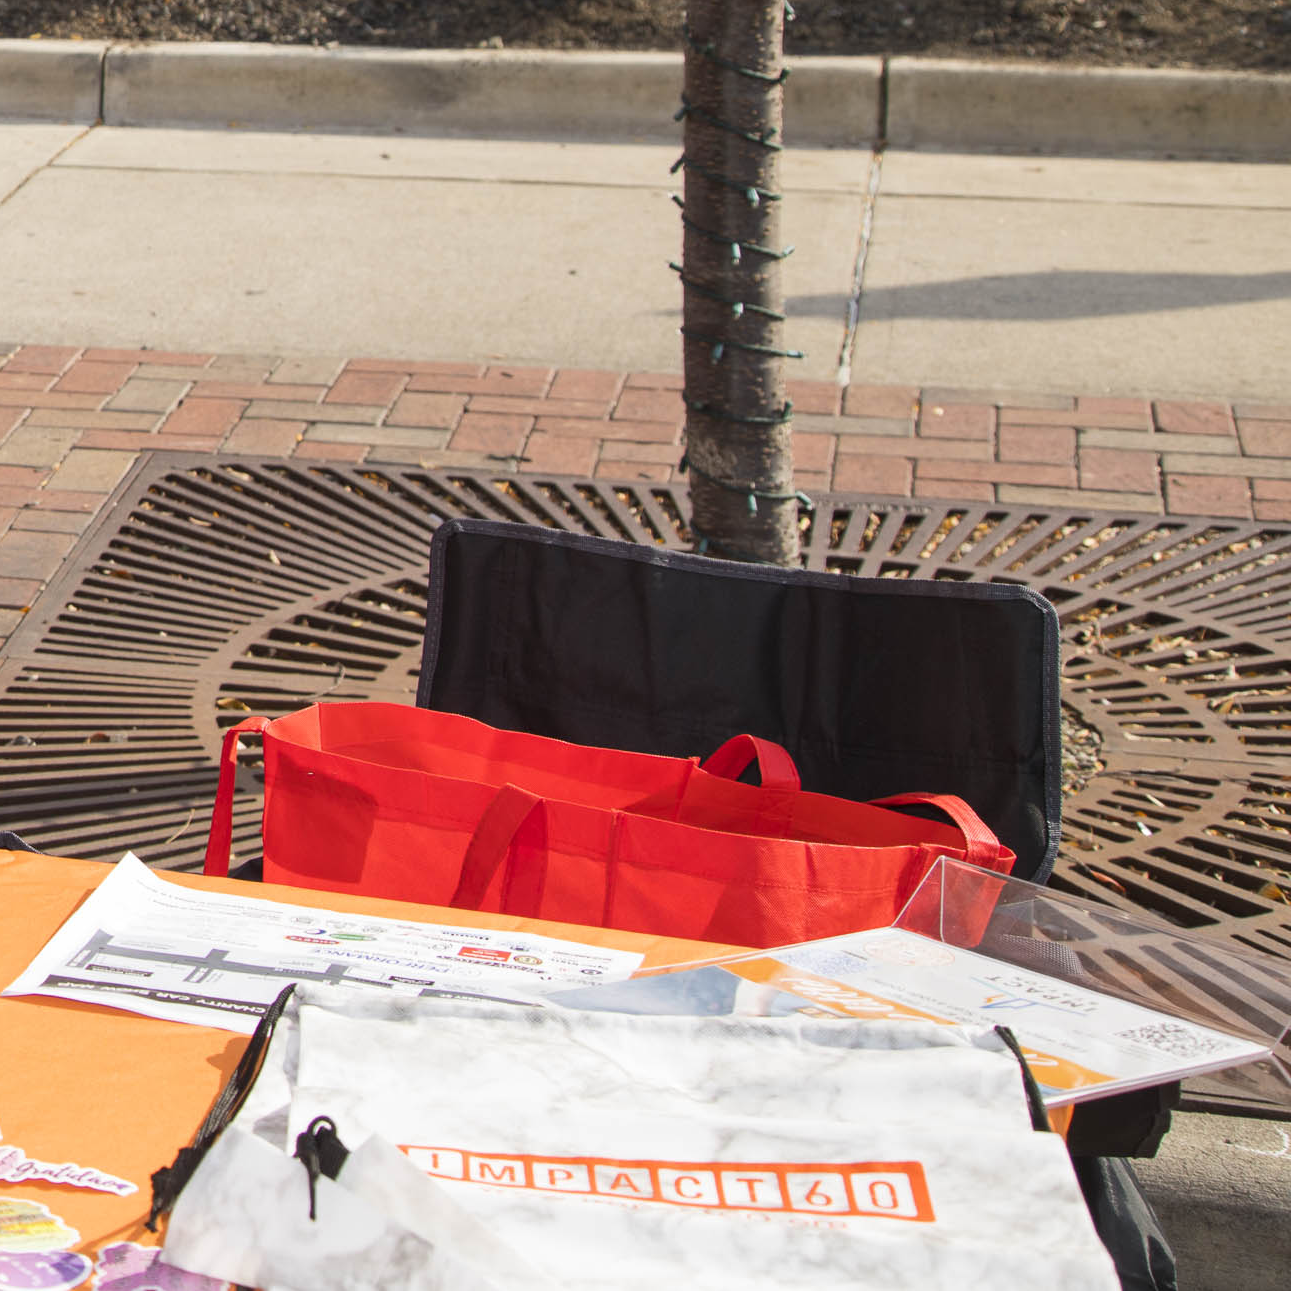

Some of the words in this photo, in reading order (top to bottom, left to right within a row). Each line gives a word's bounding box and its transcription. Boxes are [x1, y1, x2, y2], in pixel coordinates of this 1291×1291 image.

[155, 991, 191, 1002] CAR
[195, 998, 267, 1015] CHARITY
[430, 1152, 901, 1211] IMPACT60
